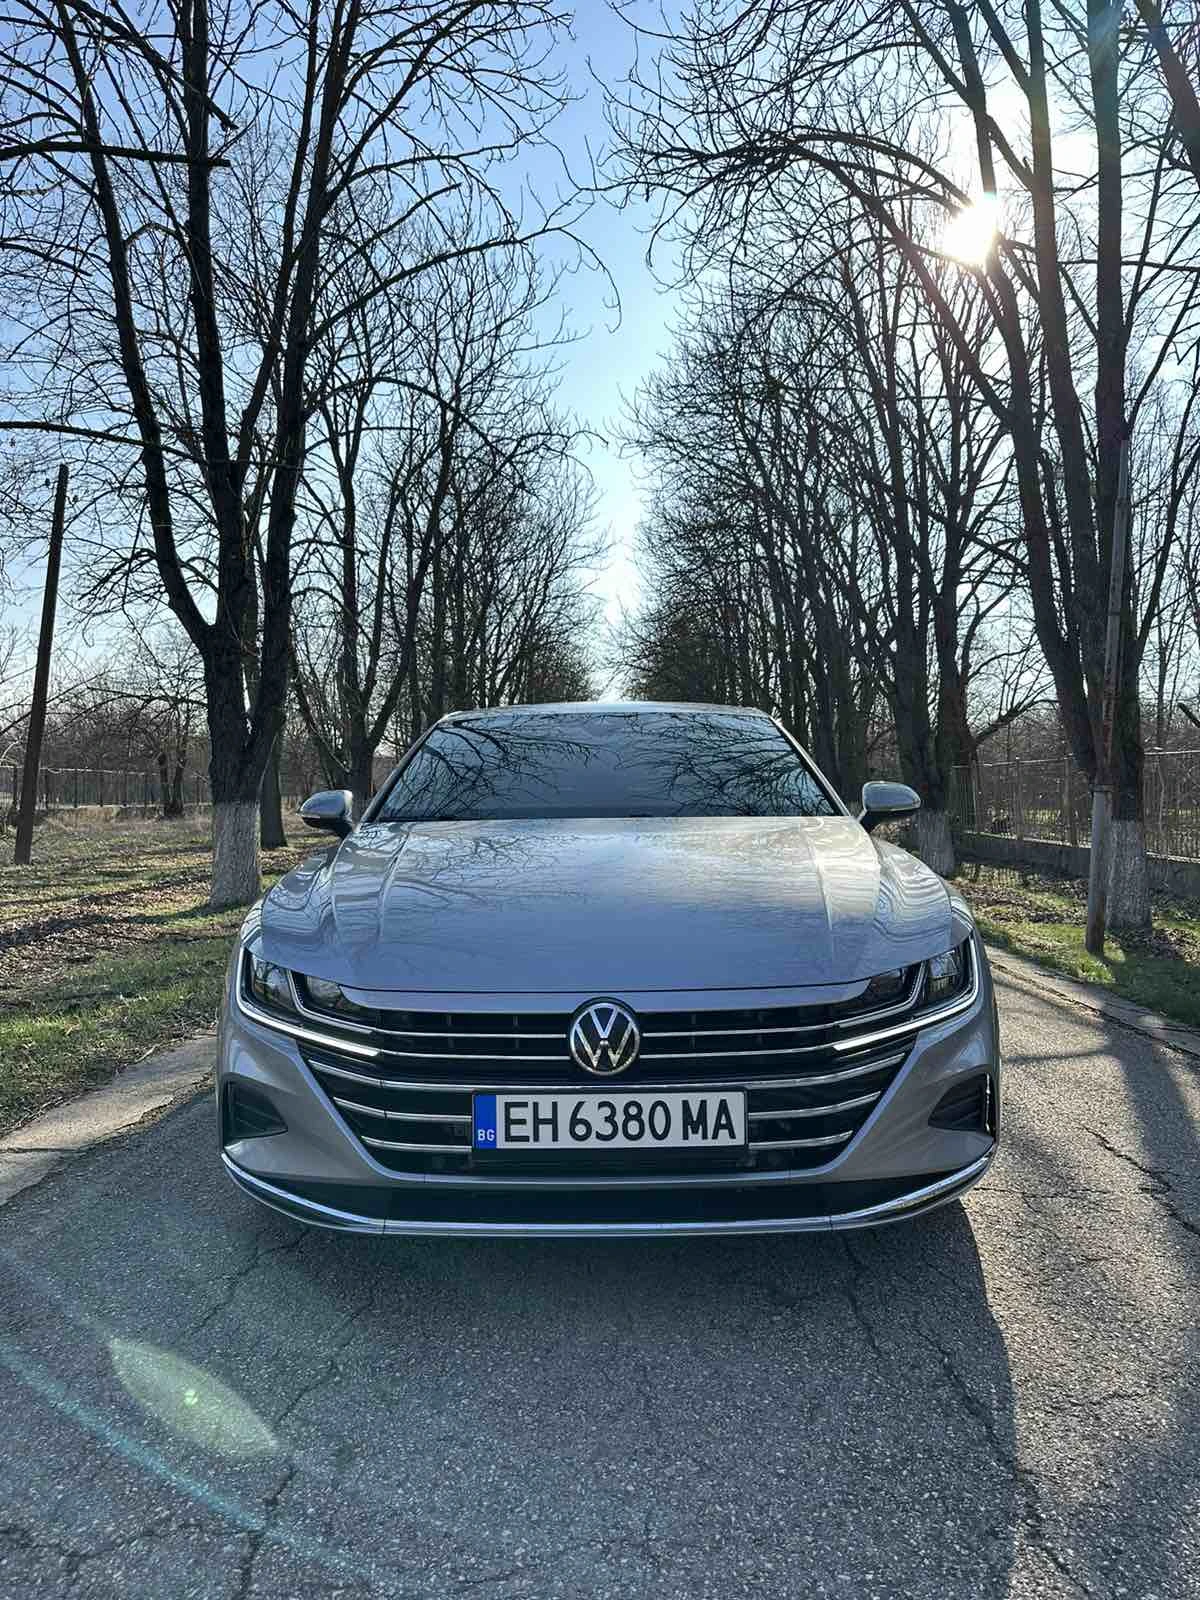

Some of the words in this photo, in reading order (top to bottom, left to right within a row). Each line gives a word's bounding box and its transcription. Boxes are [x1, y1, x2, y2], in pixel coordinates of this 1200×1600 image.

[571, 1003, 640, 1075] VW
[477, 1129, 496, 1142] BG
[503, 1101, 559, 1143] EH
[568, 1100, 672, 1142] 6380
[681, 1099, 736, 1141] MA
